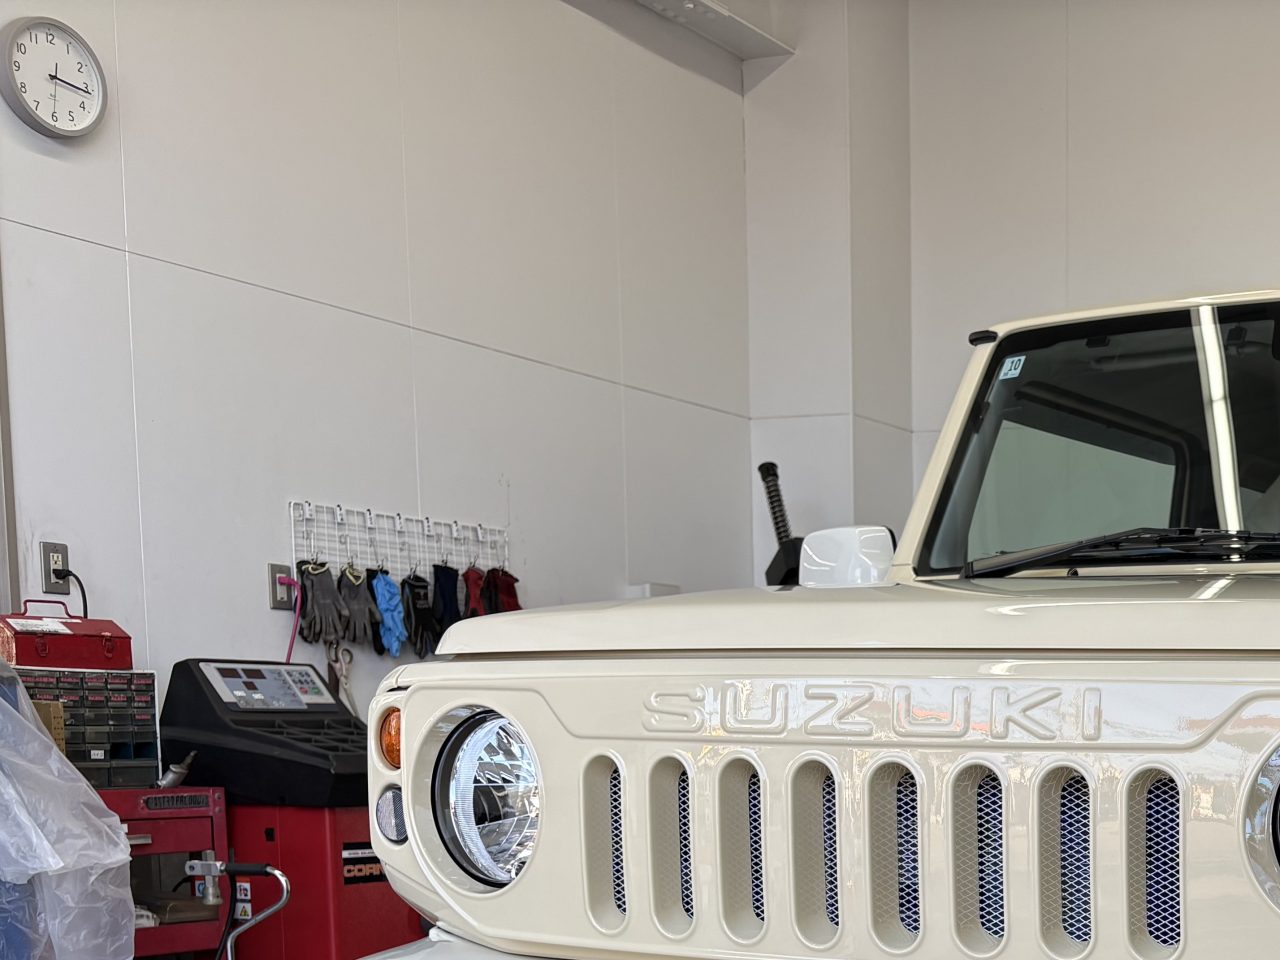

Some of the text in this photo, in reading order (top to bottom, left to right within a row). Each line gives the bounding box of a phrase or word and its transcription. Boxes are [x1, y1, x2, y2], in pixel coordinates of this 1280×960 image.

[29, 31, 38, 45] 11
[45, 31, 56, 46] 12
[16, 42, 27, 55] 10
[13, 60, 21, 72] 9
[76, 61, 84, 74] 2
[19, 81, 27, 94] 8
[82, 82, 89, 94] 3
[33, 99, 40, 111] 7
[79, 100, 86, 112] 4
[51, 111, 58, 123] 6
[68, 110, 75, 122] 5
[1007, 358, 1022, 372] 10
[641, 681, 1102, 742] SUZUKI
